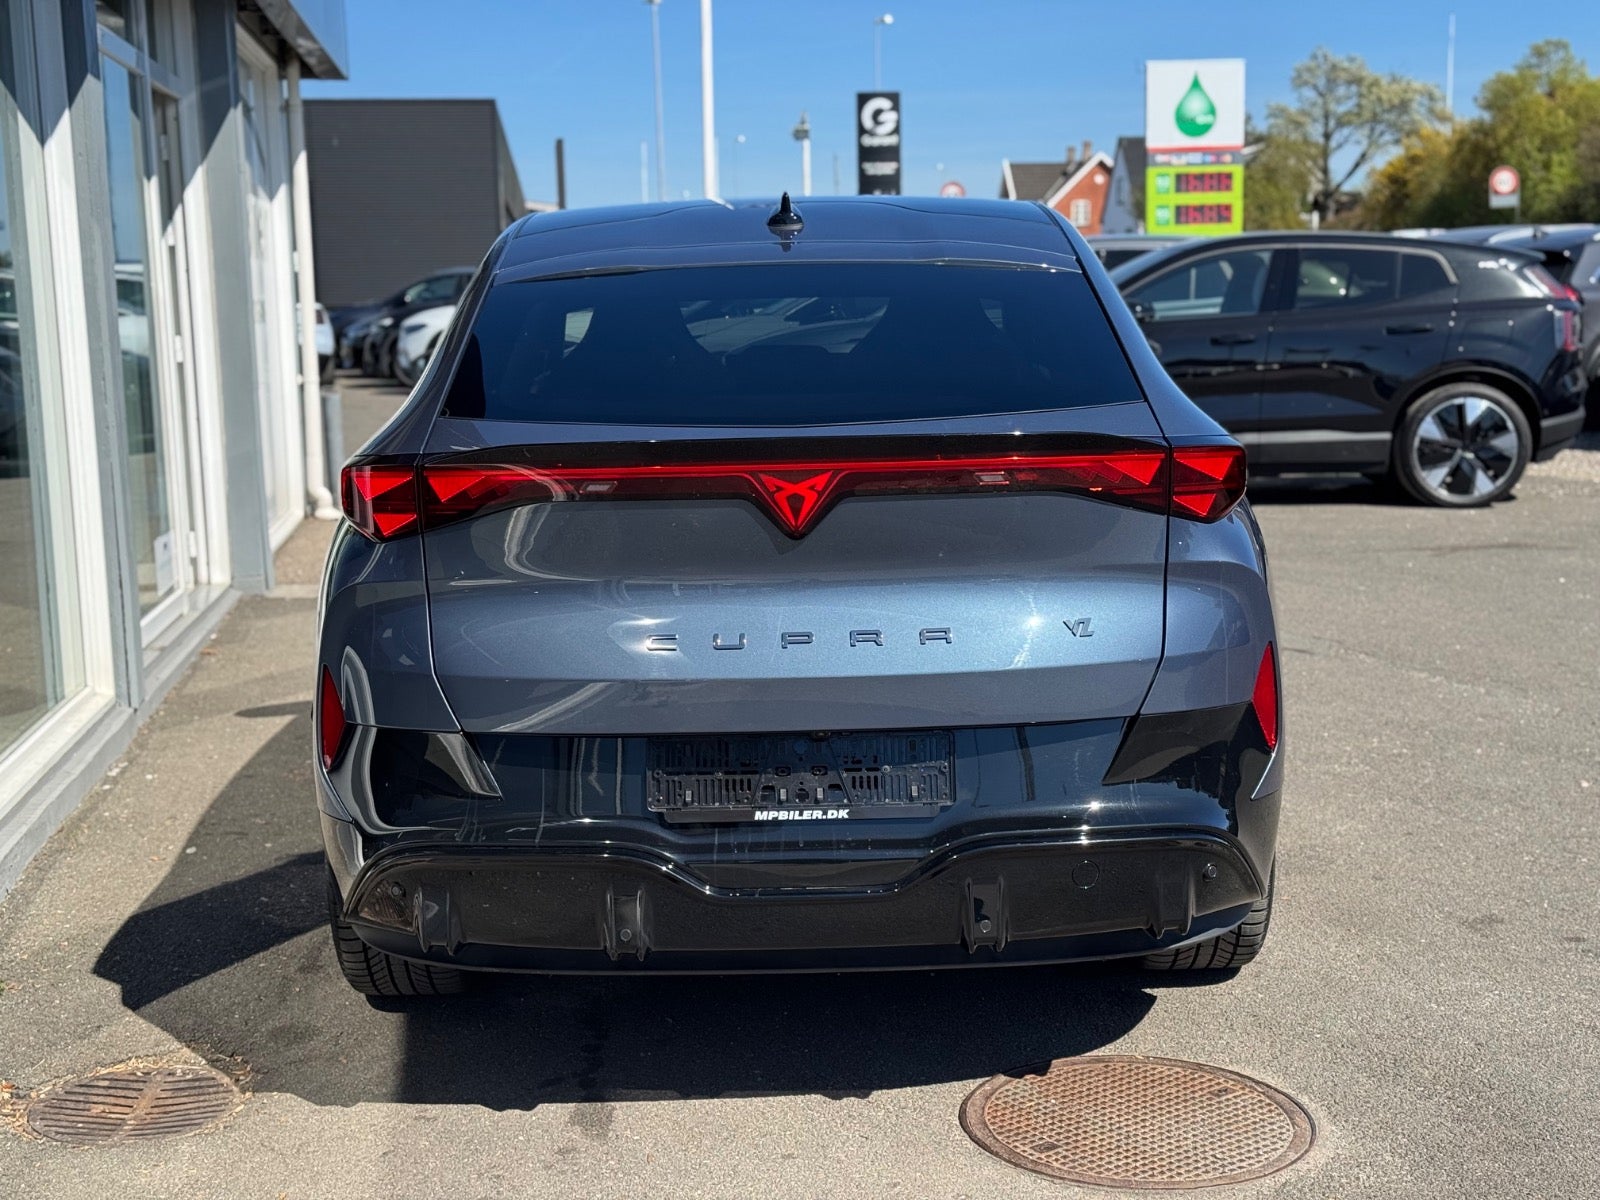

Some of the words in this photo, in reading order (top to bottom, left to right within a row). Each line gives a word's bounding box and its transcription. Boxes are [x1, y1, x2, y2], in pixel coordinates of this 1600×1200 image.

[1062, 617, 1095, 637] VZ
[646, 626, 953, 651] CUPRA
[754, 809, 849, 820] MPBILER.DK
